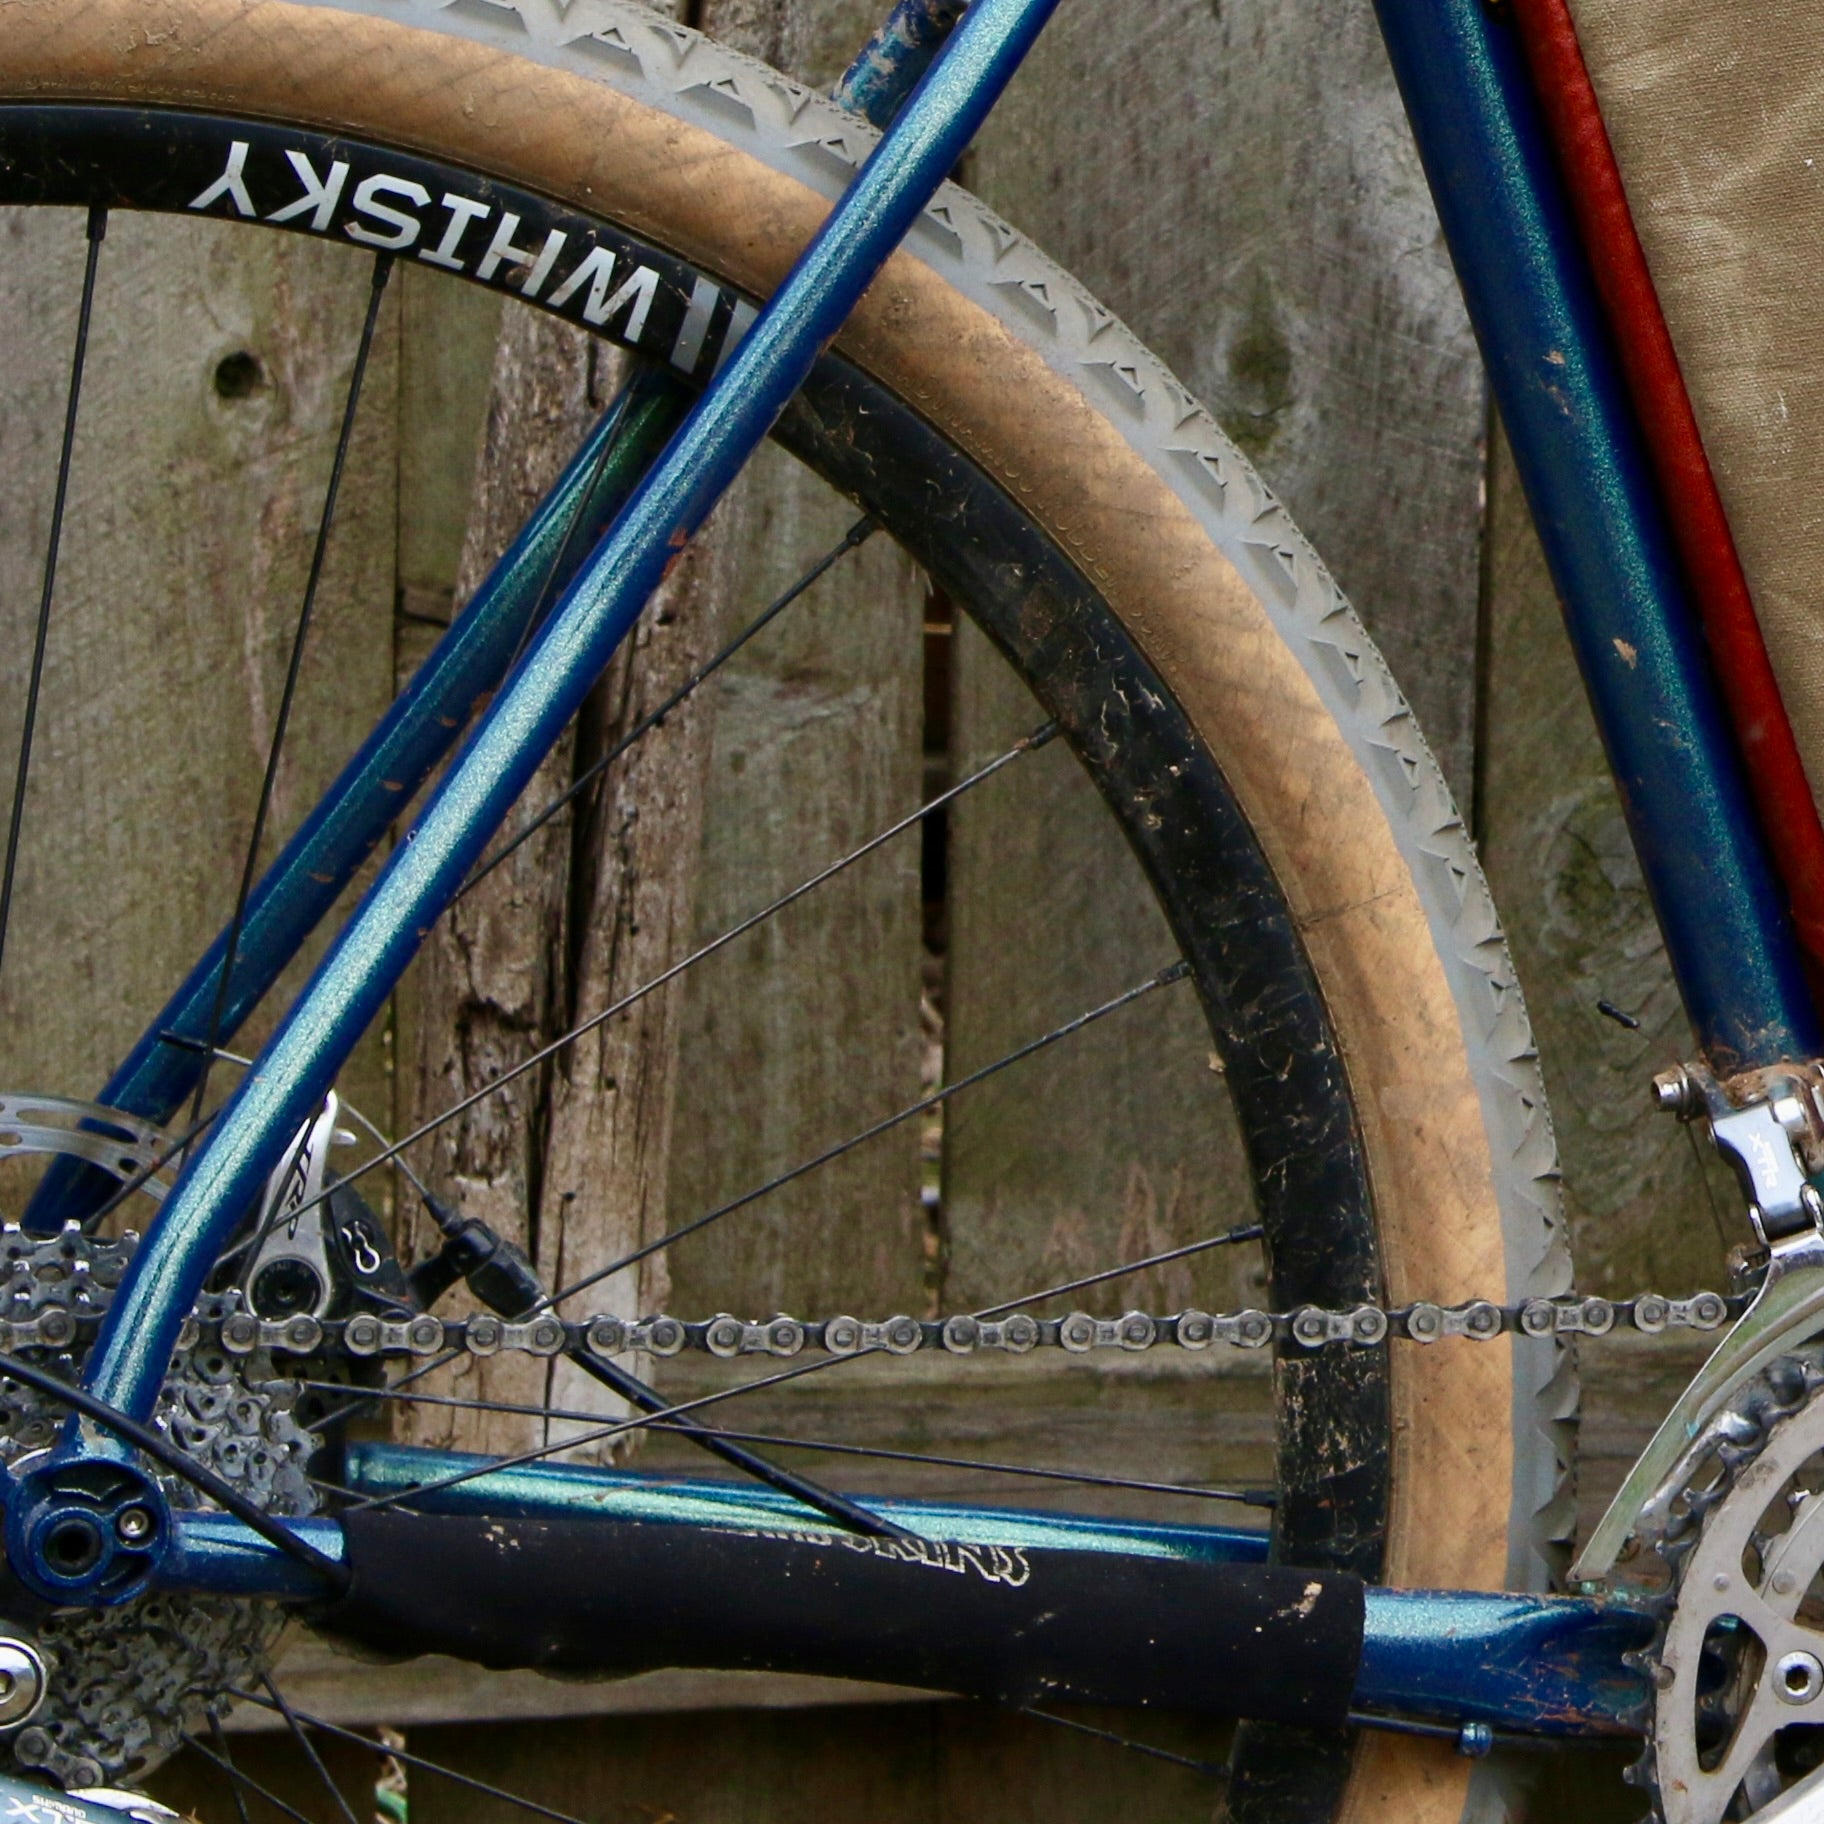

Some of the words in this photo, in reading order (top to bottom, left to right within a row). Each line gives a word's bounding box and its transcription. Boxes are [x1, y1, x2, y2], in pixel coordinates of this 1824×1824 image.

[188, 140, 661, 344] WHISKY
[1747, 1131, 1780, 1191] XTR
[5, 1795, 97, 1824] XT
